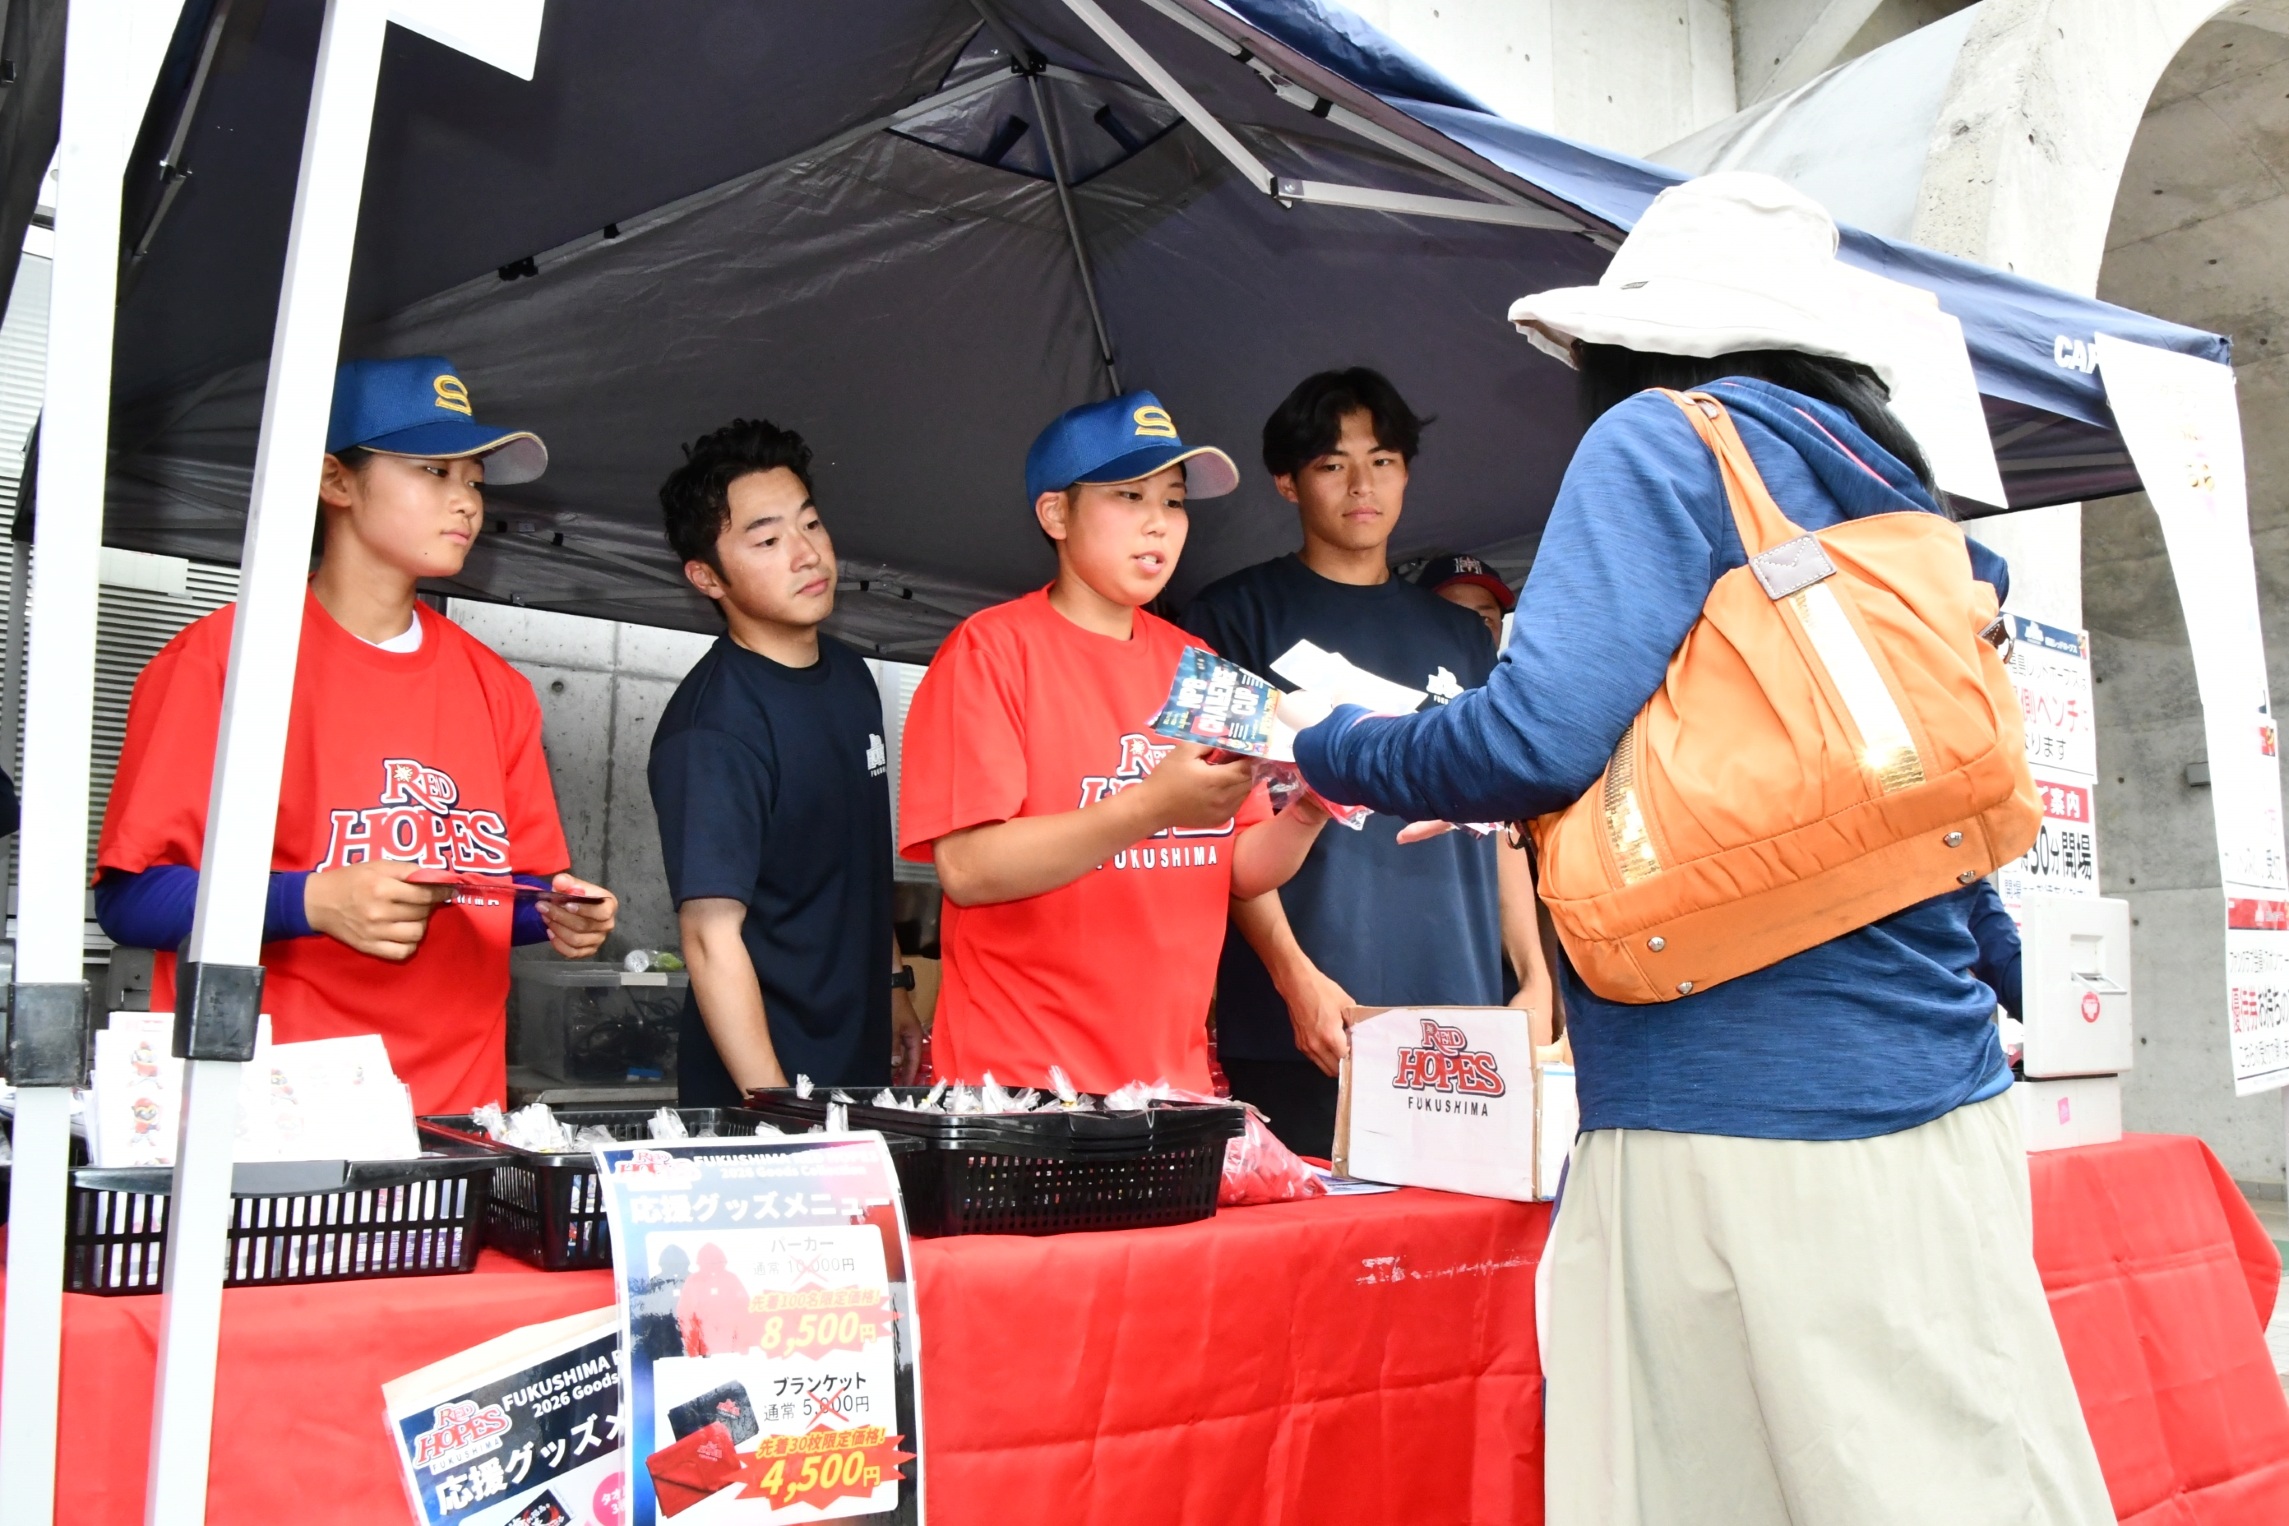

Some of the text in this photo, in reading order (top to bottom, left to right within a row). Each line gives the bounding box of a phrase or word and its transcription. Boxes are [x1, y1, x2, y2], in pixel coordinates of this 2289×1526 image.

[433, 375, 472, 416] S
[1134, 405, 1178, 439] S
[1230, 686, 1260, 716] CUP
[380, 757, 459, 816] RED
[316, 806, 513, 876] HOPES
[1096, 845, 1218, 870] UKUSHIMA
[1420, 1018, 1468, 1058] RED
[1392, 1047, 1506, 1098] HOPES
[1408, 1096, 1488, 1117] FUKUSHIMA
[693, 1152, 789, 1167] FUKUSHIMA
[757, 1165, 799, 1178] Goods
[630, 1191, 892, 1225] 応援グッズメニュー
[771, 1236, 834, 1253] パーカー
[760, 1311, 877, 1356] 8,500円
[501, 1355, 611, 1412] FUKUSHIMA
[531, 1372, 619, 1418] 2026 Goods
[773, 1371, 867, 1396] ブランケット
[437, 1403, 476, 1427] RED
[763, 1401, 796, 1422] 通常
[415, 1407, 510, 1466] HOPES
[432, 1438, 500, 1471] FUKUSHIMA
[760, 1450, 881, 1504] 4,500円
